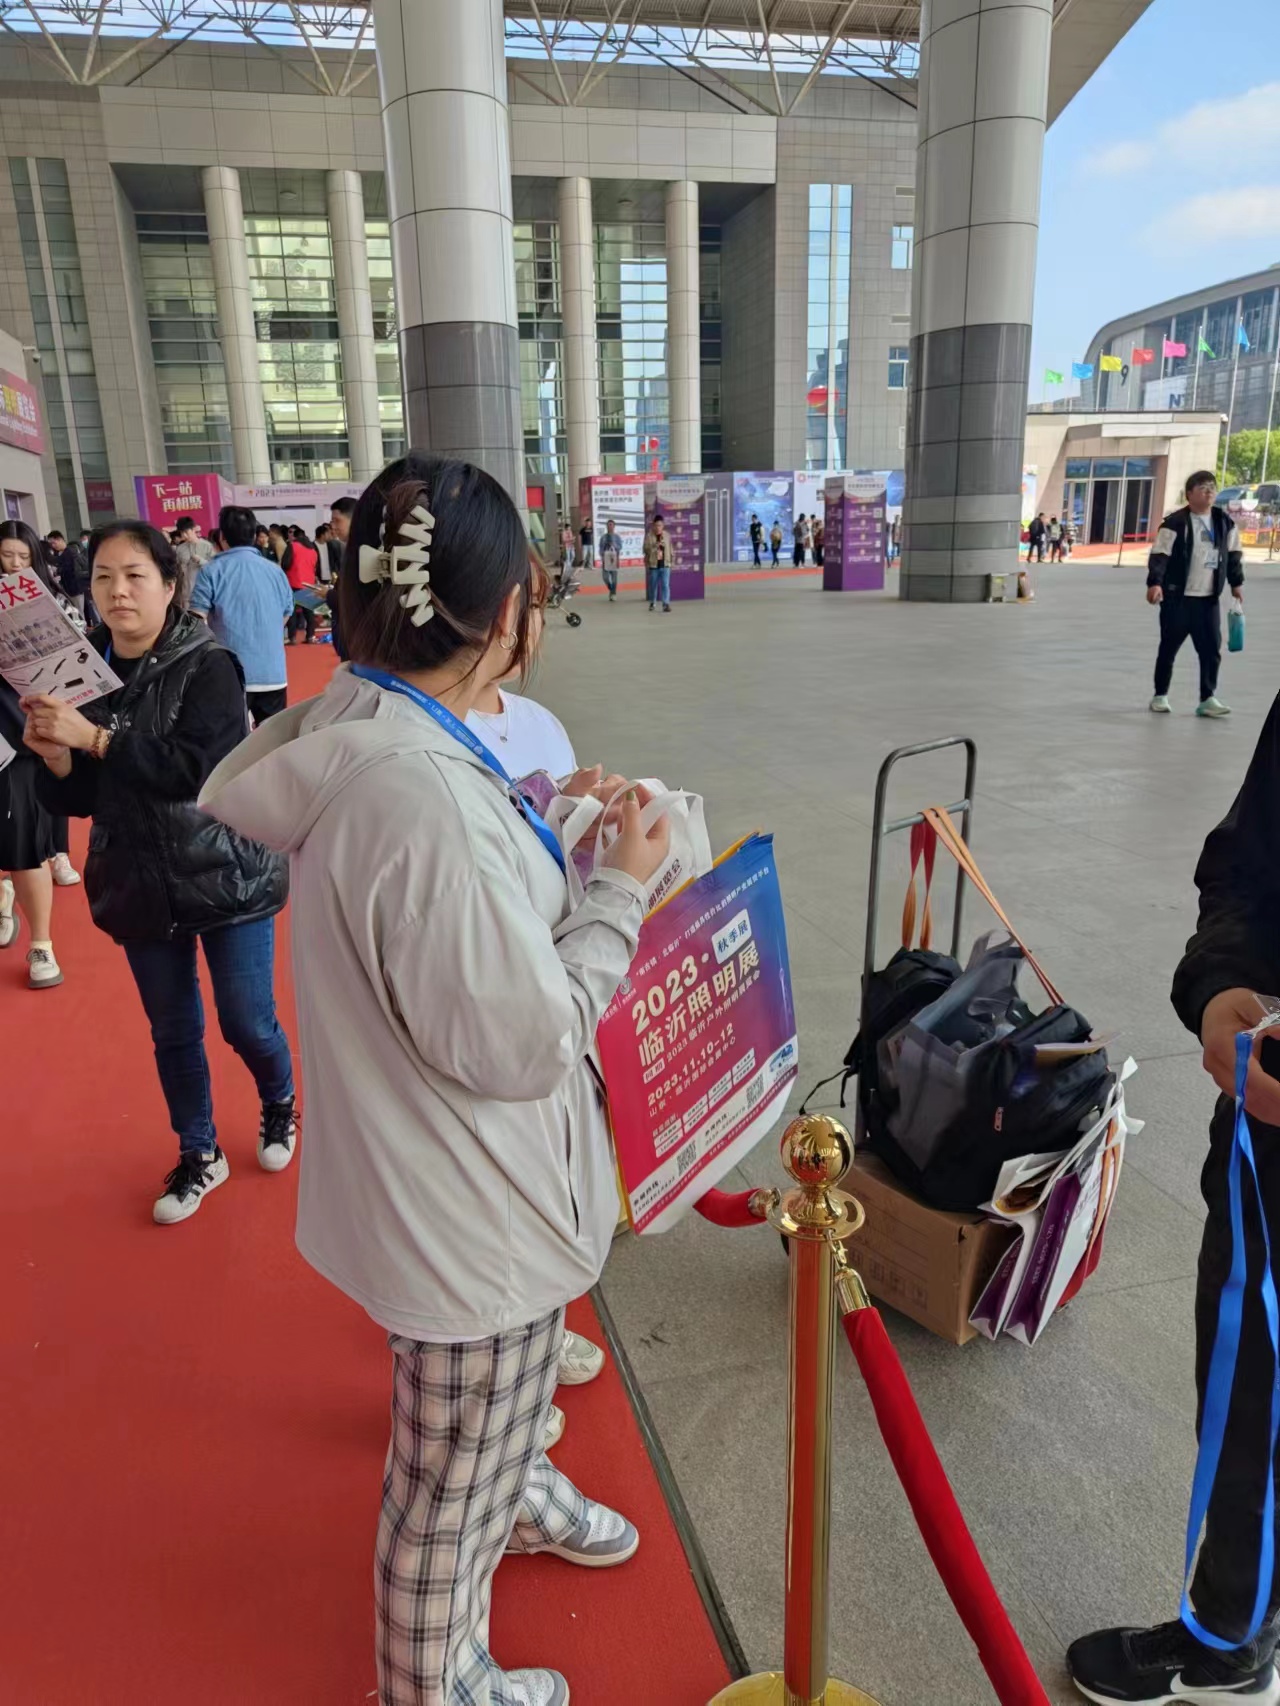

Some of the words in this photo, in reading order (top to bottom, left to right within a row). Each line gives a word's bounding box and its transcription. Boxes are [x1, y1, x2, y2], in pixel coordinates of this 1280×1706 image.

[1121, 364, 1129, 387] 9
[152, 480, 193, 499] 下一站
[162, 494, 203, 513] 再相聚
[0, 575, 43, 610] 大全
[716, 919, 749, 953] 秋季展
[638, 939, 760, 1067] 临沂照明展
[648, 1022, 734, 1106] 2023.11.10-12
